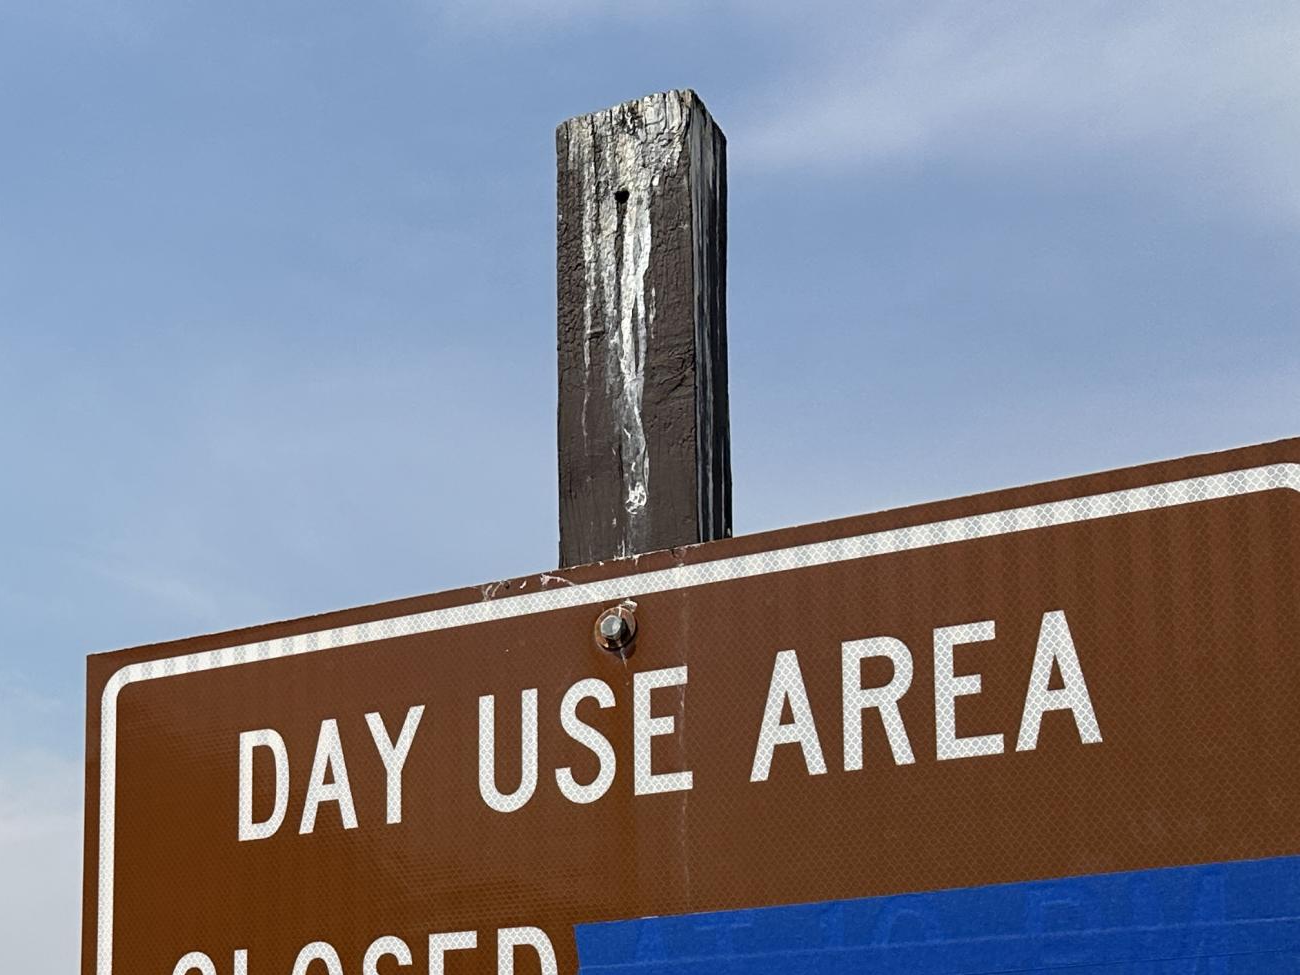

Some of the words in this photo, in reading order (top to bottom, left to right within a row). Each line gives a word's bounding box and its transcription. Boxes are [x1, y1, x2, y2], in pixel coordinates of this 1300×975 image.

[238, 704, 426, 842] DAY
[478, 666, 693, 813] USE
[749, 609, 1103, 783] AREA
